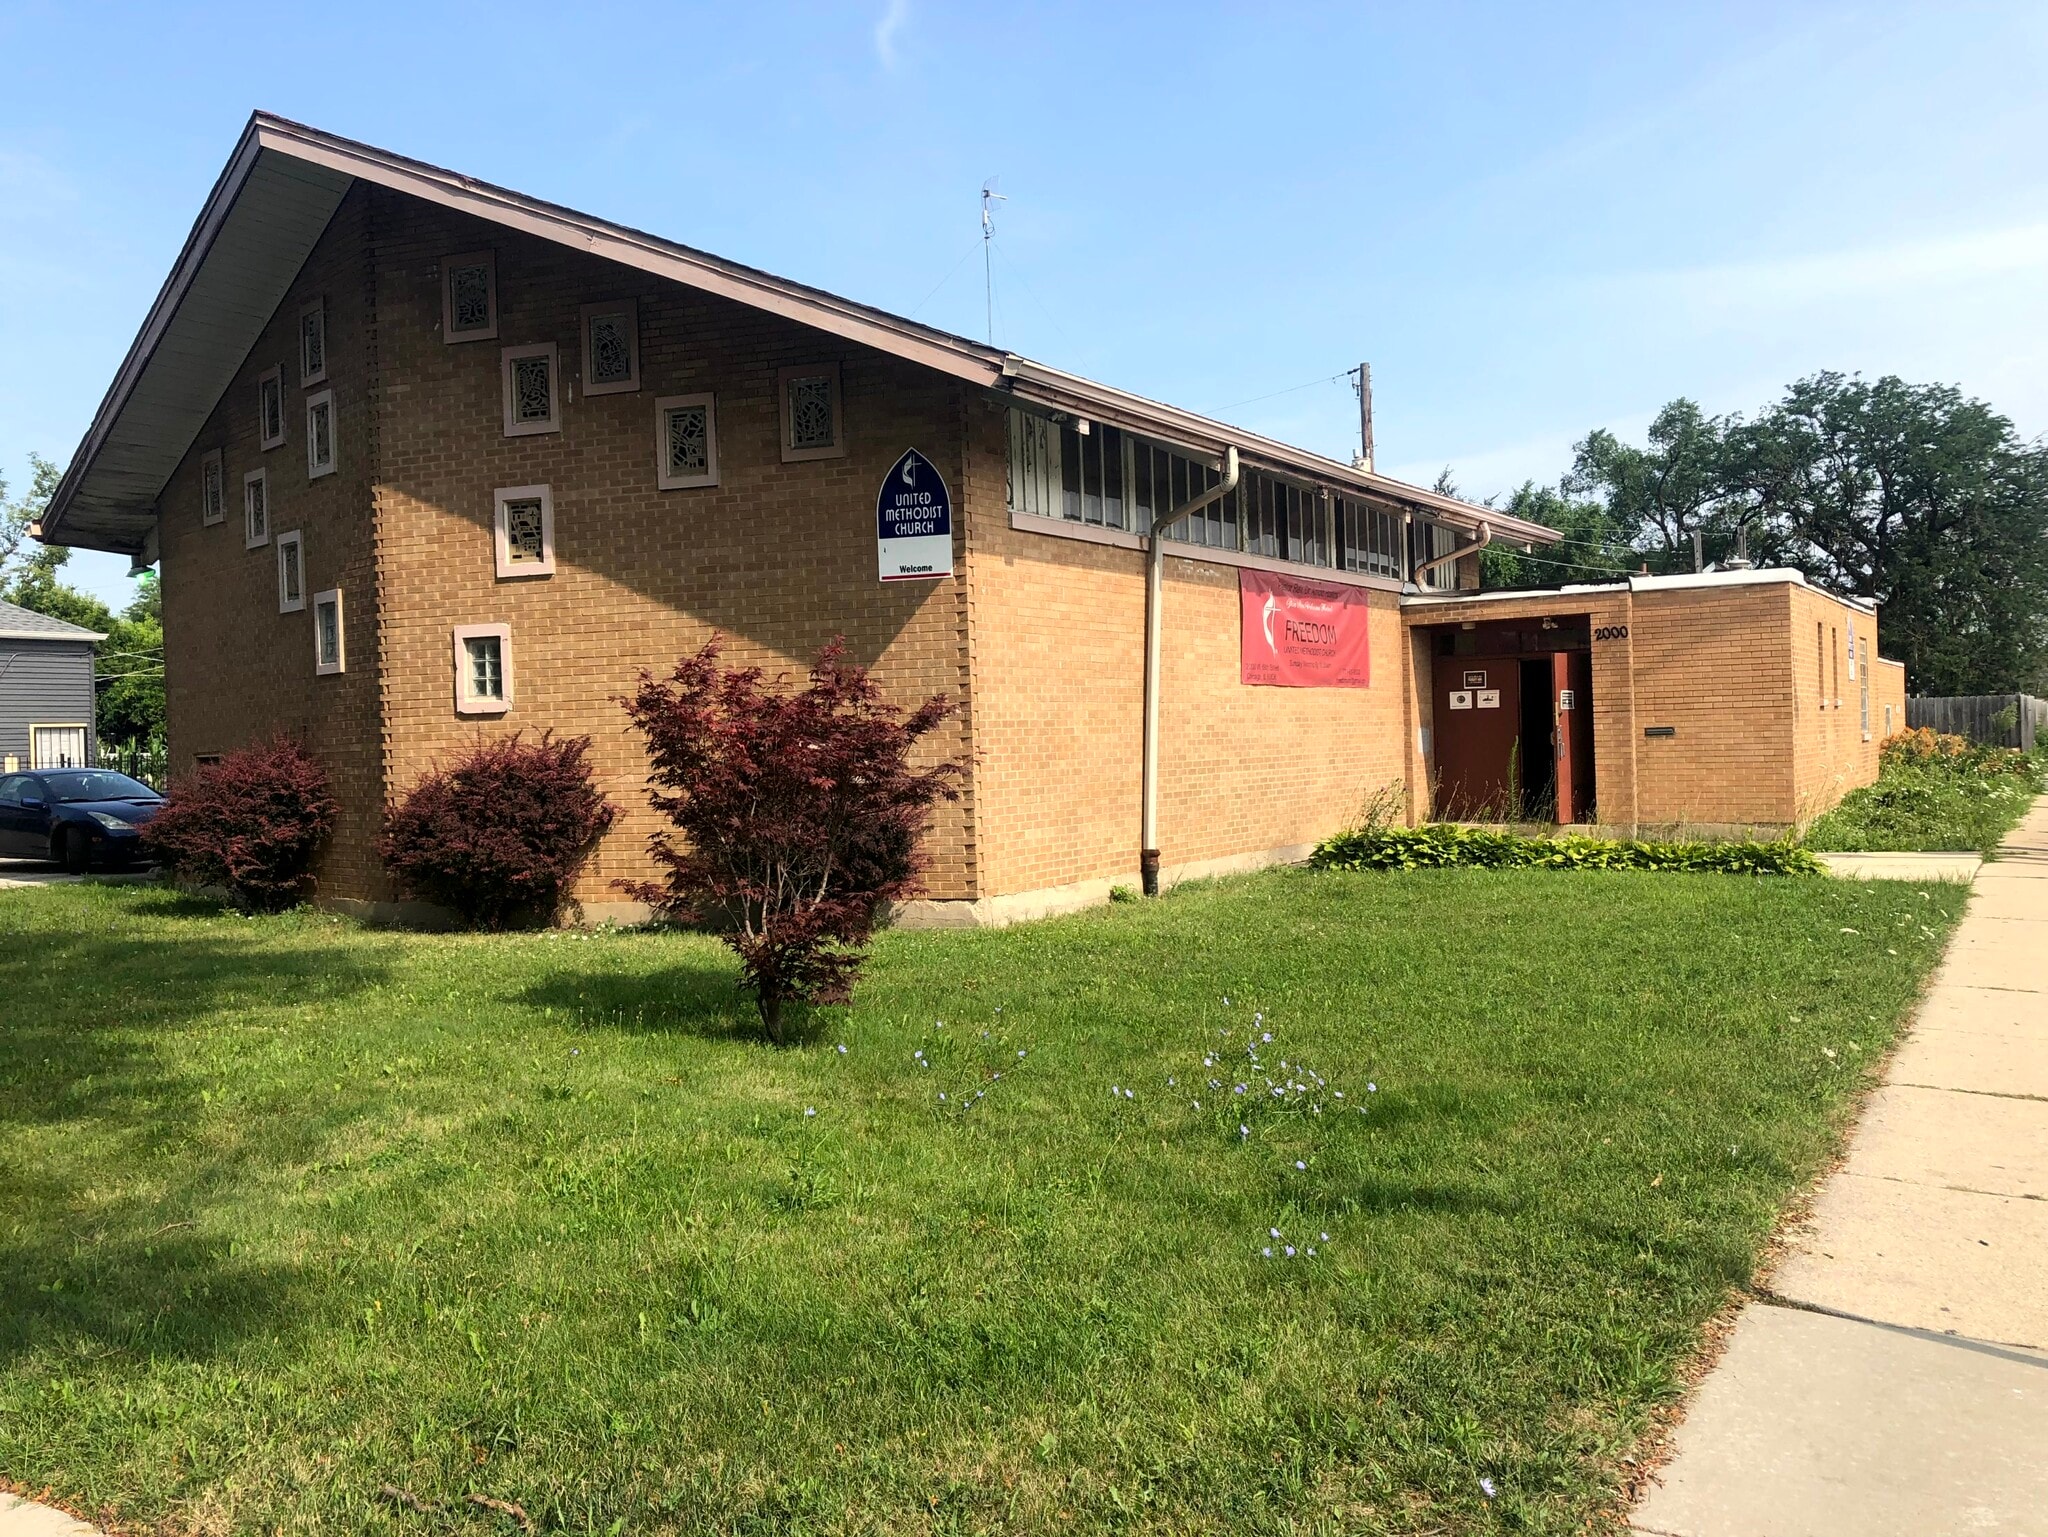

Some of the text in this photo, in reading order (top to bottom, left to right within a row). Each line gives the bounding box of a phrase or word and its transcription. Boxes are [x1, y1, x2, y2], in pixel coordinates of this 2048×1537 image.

[895, 492, 932, 507] UNITED
[885, 506, 943, 522] METHODIST
[894, 521, 934, 535] CHURCH
[899, 564, 933, 574] Welcome
[1285, 619, 1337, 645] FREEDOM
[1594, 625, 1629, 641] 2000
